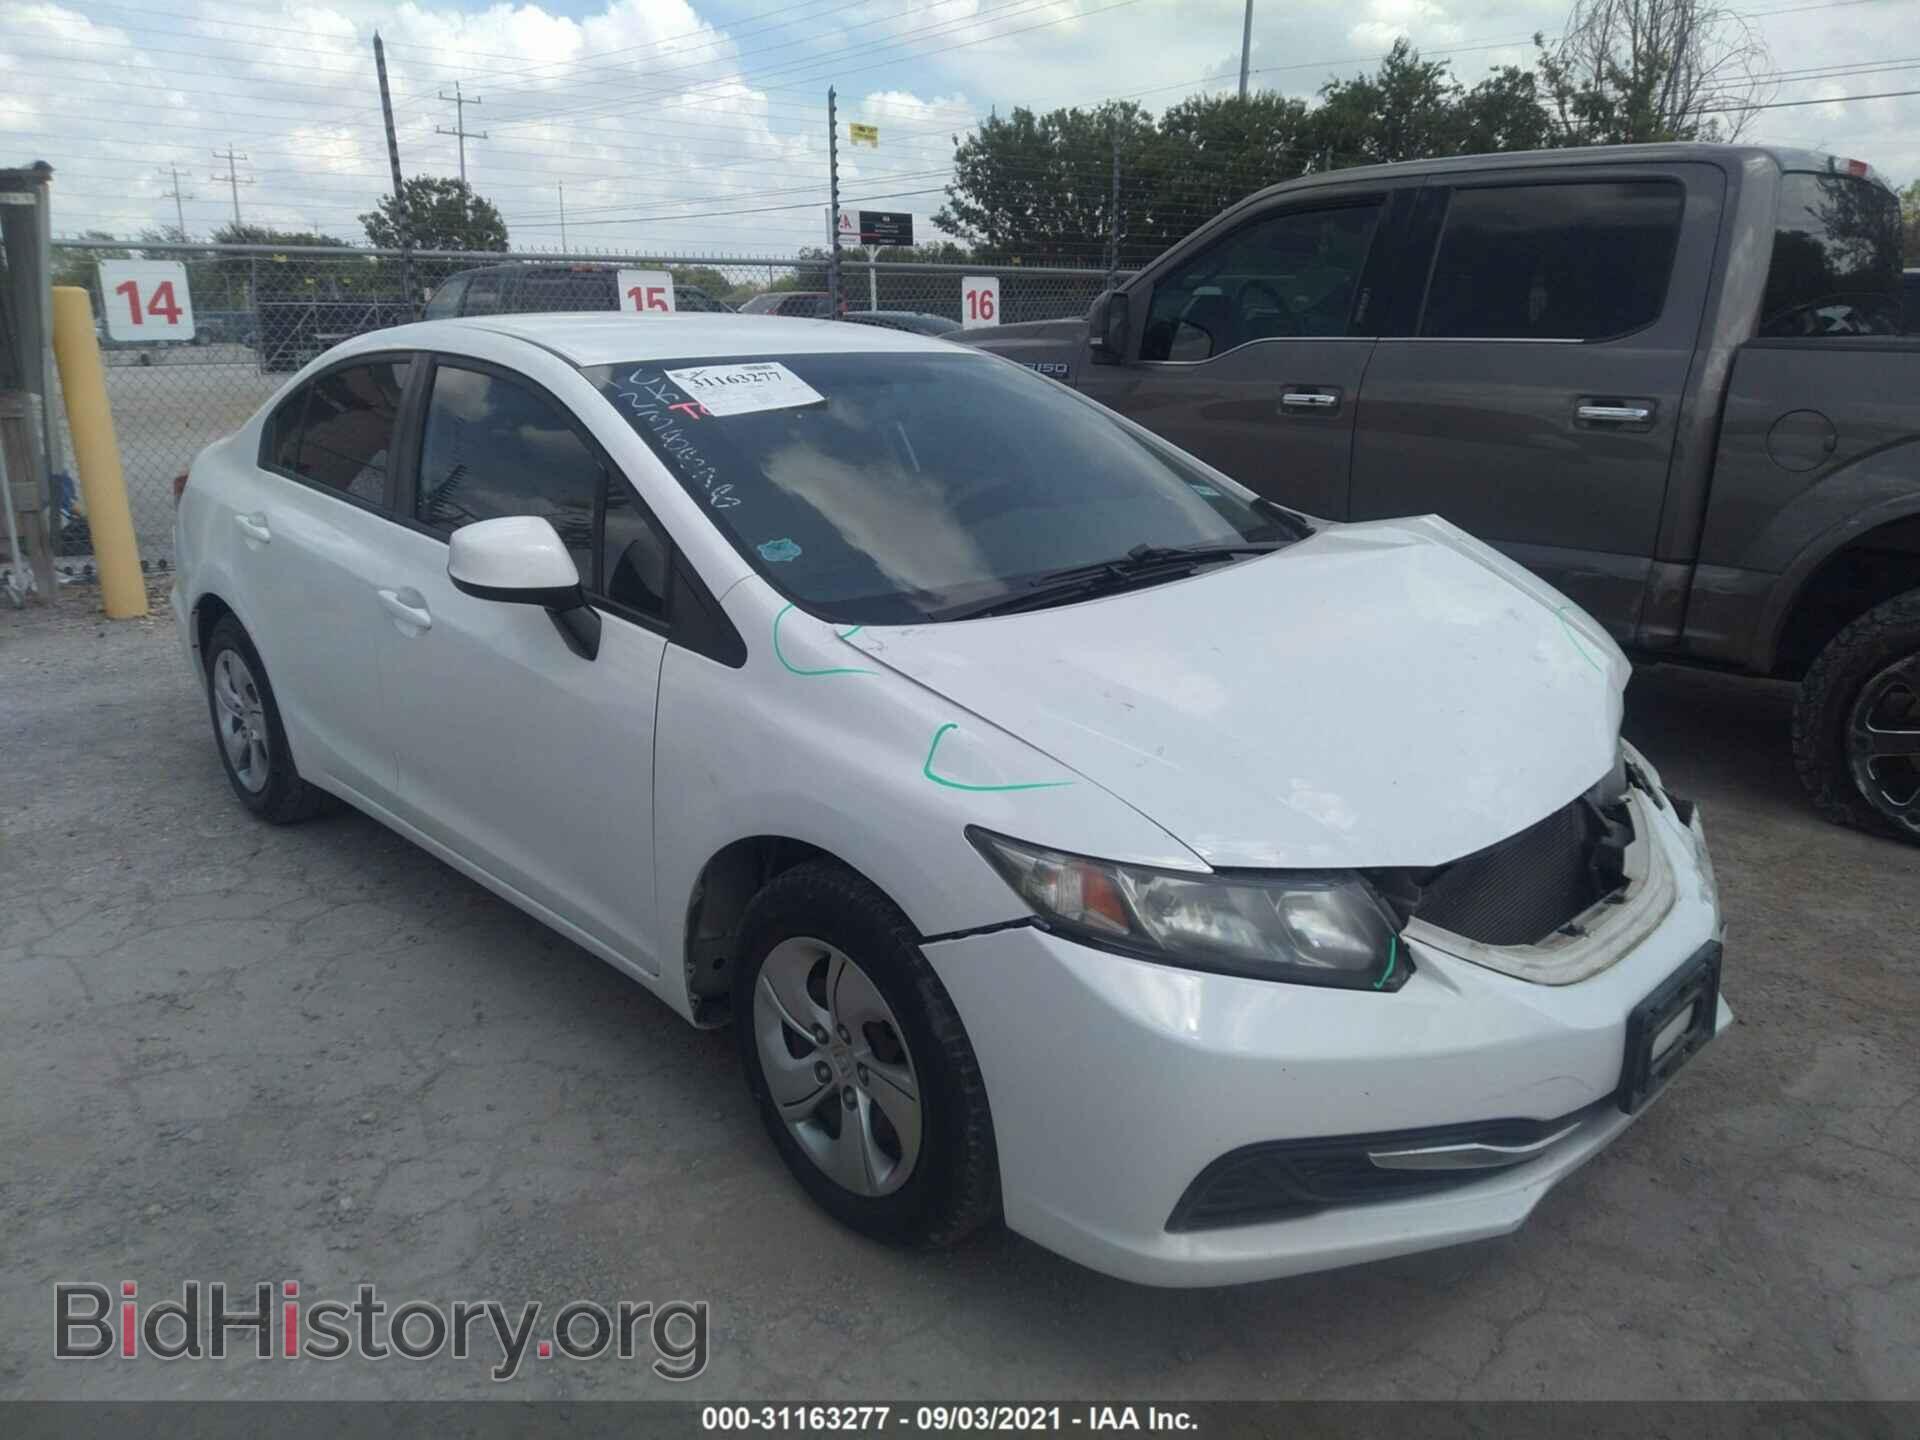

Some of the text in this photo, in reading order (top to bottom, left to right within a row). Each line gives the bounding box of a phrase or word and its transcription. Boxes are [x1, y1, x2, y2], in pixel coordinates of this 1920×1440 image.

[115, 280, 184, 325] 14
[627, 286, 669, 312] 15
[966, 289, 994, 320] 16
[692, 371, 782, 388] 31163277
